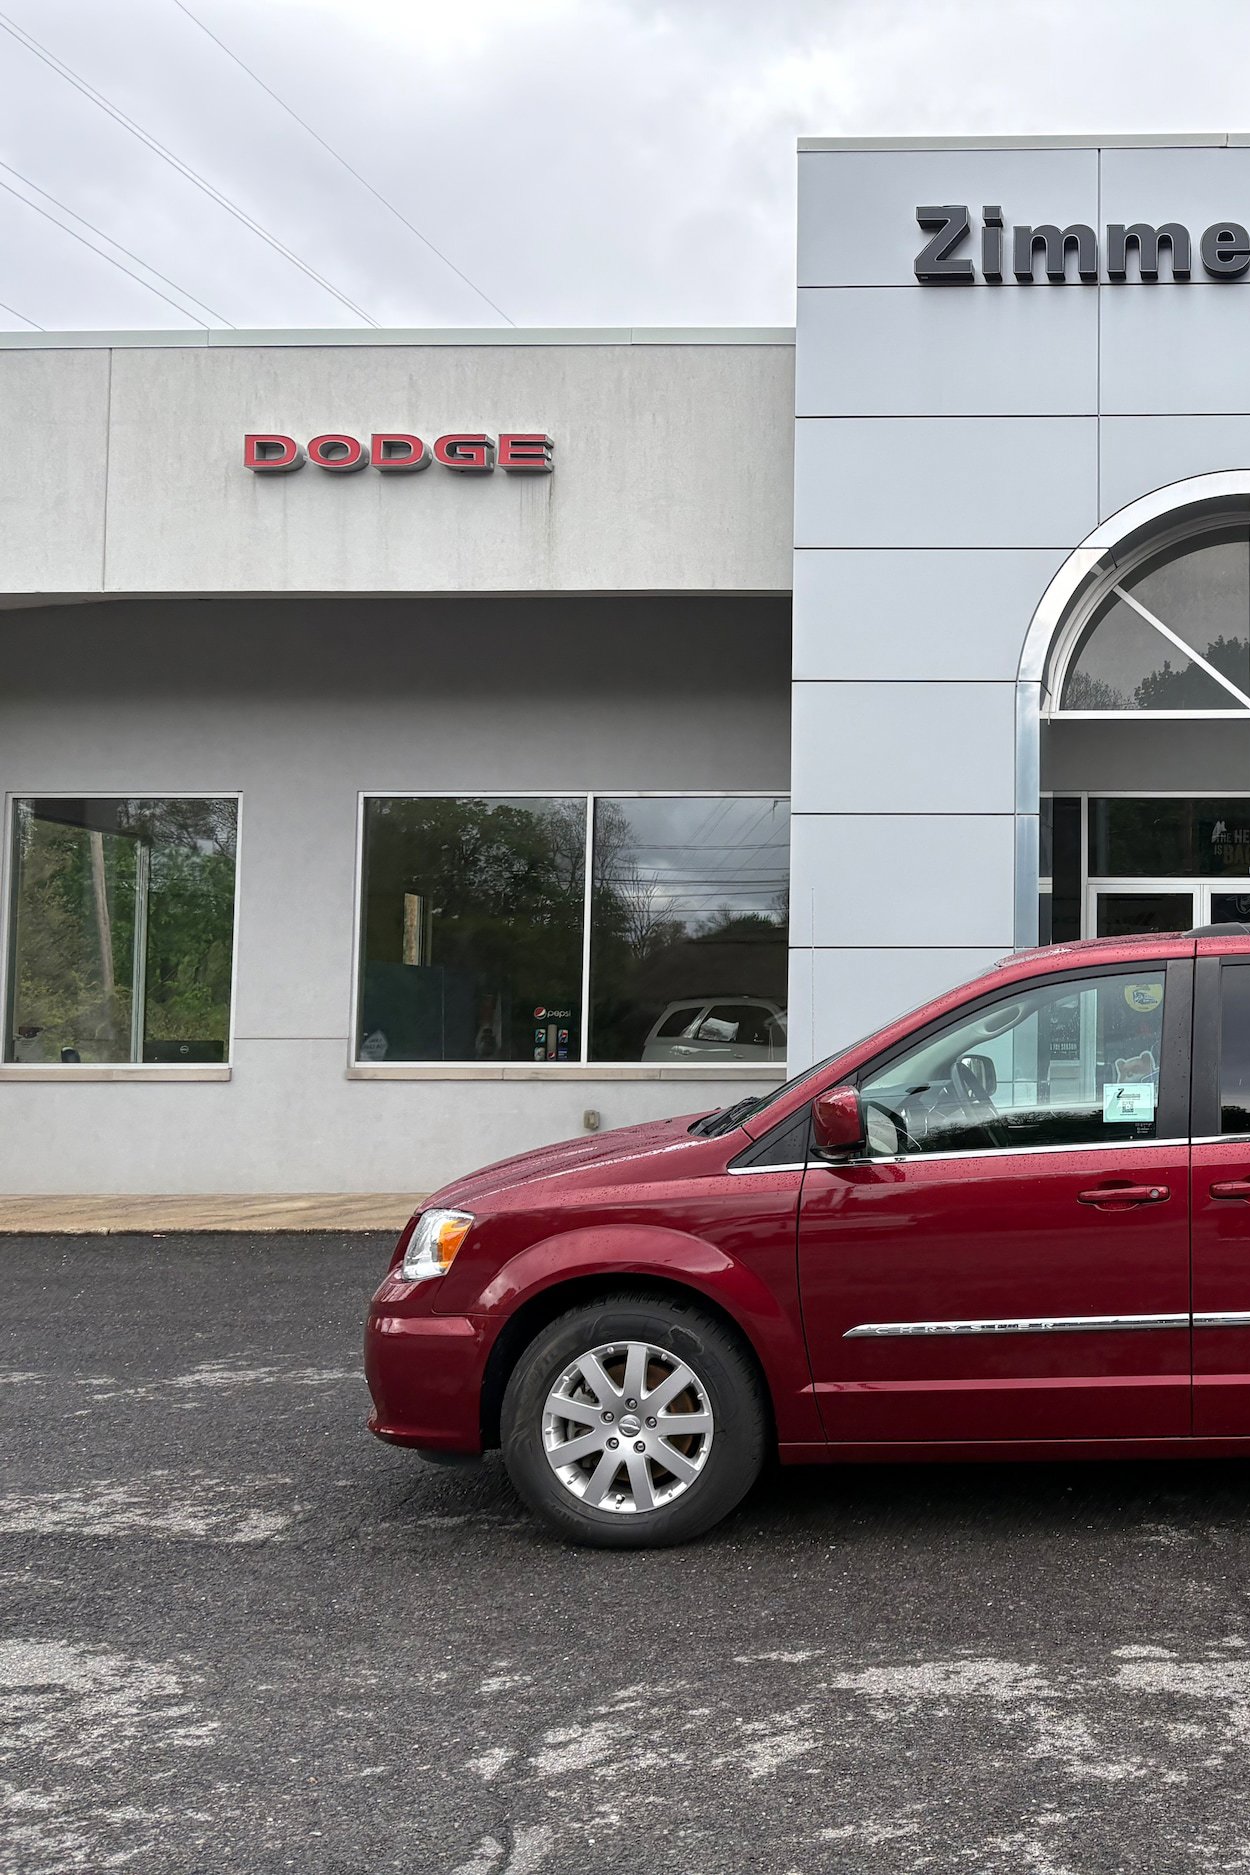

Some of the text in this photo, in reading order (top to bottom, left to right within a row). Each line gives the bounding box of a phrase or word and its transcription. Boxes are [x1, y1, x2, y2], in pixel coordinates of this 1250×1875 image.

[243, 432, 555, 473] DODGE
[1214, 844, 1223, 856] IS
[547, 1010, 571, 1018] pepsi
[875, 1322, 1054, 1334] CHRYSLER
